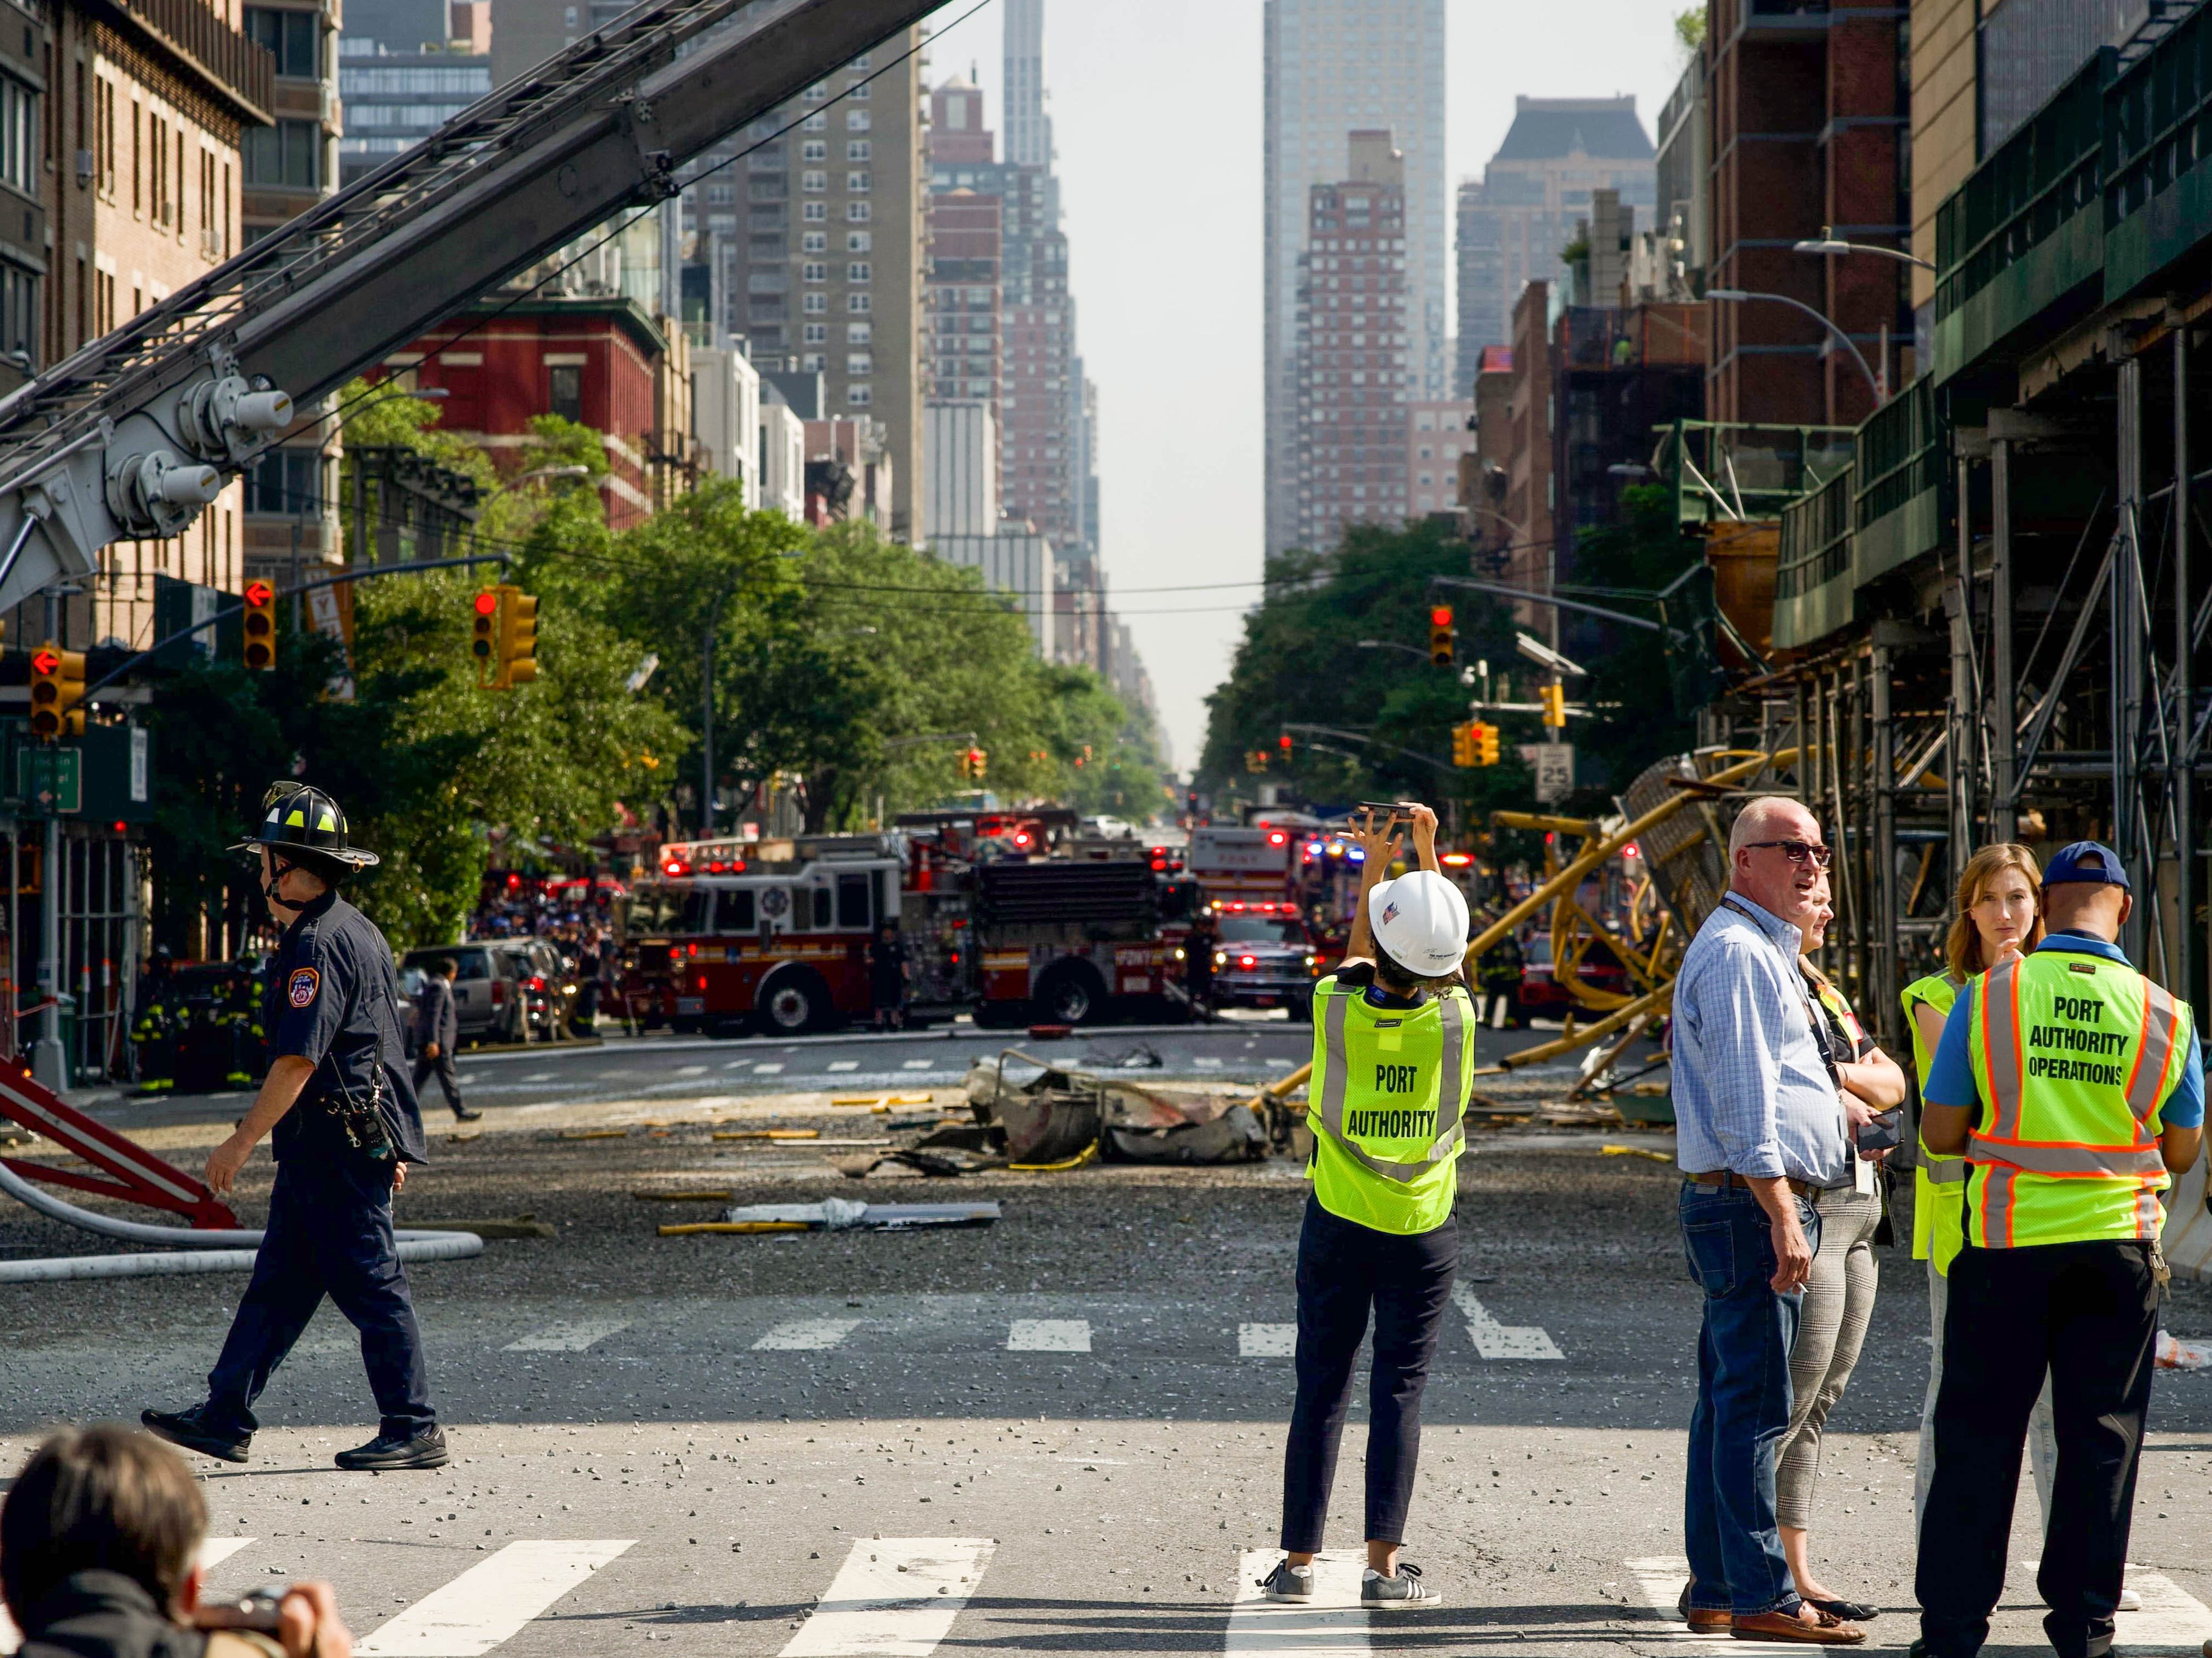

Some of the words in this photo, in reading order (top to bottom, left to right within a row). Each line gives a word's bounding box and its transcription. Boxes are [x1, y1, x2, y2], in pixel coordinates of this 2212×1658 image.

[1542, 766, 1569, 784] 25
[2054, 996, 2104, 1023] PORT
[2029, 1025, 2129, 1056] AUTHORITY
[1375, 1064, 1417, 1093] PORT
[2029, 1056, 2122, 1086] OPERATIONS
[1348, 1109, 1436, 1138] AUTHORITY
